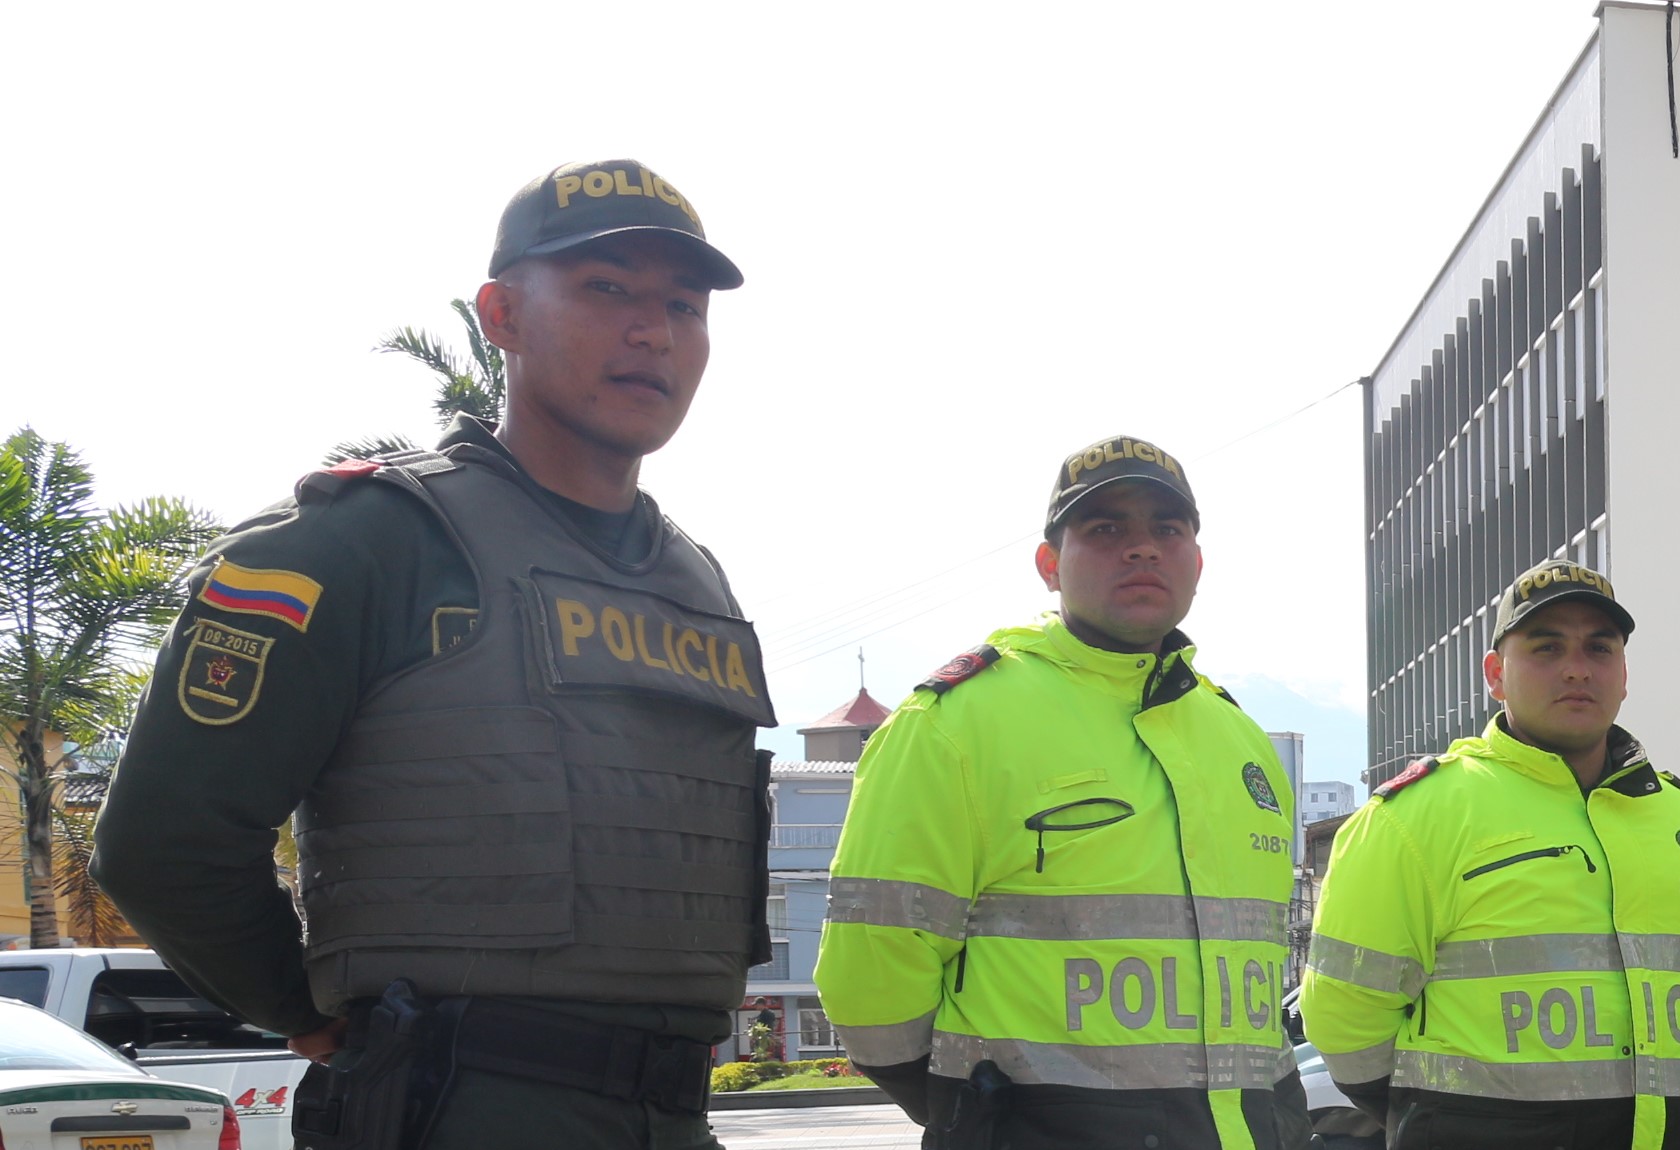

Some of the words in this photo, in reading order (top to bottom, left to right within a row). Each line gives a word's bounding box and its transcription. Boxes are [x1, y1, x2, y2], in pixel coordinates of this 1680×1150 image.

[1068, 439, 1180, 484] POLICIA
[556, 598, 756, 698] POLICIA
[1065, 957, 1284, 1031] POLICI
